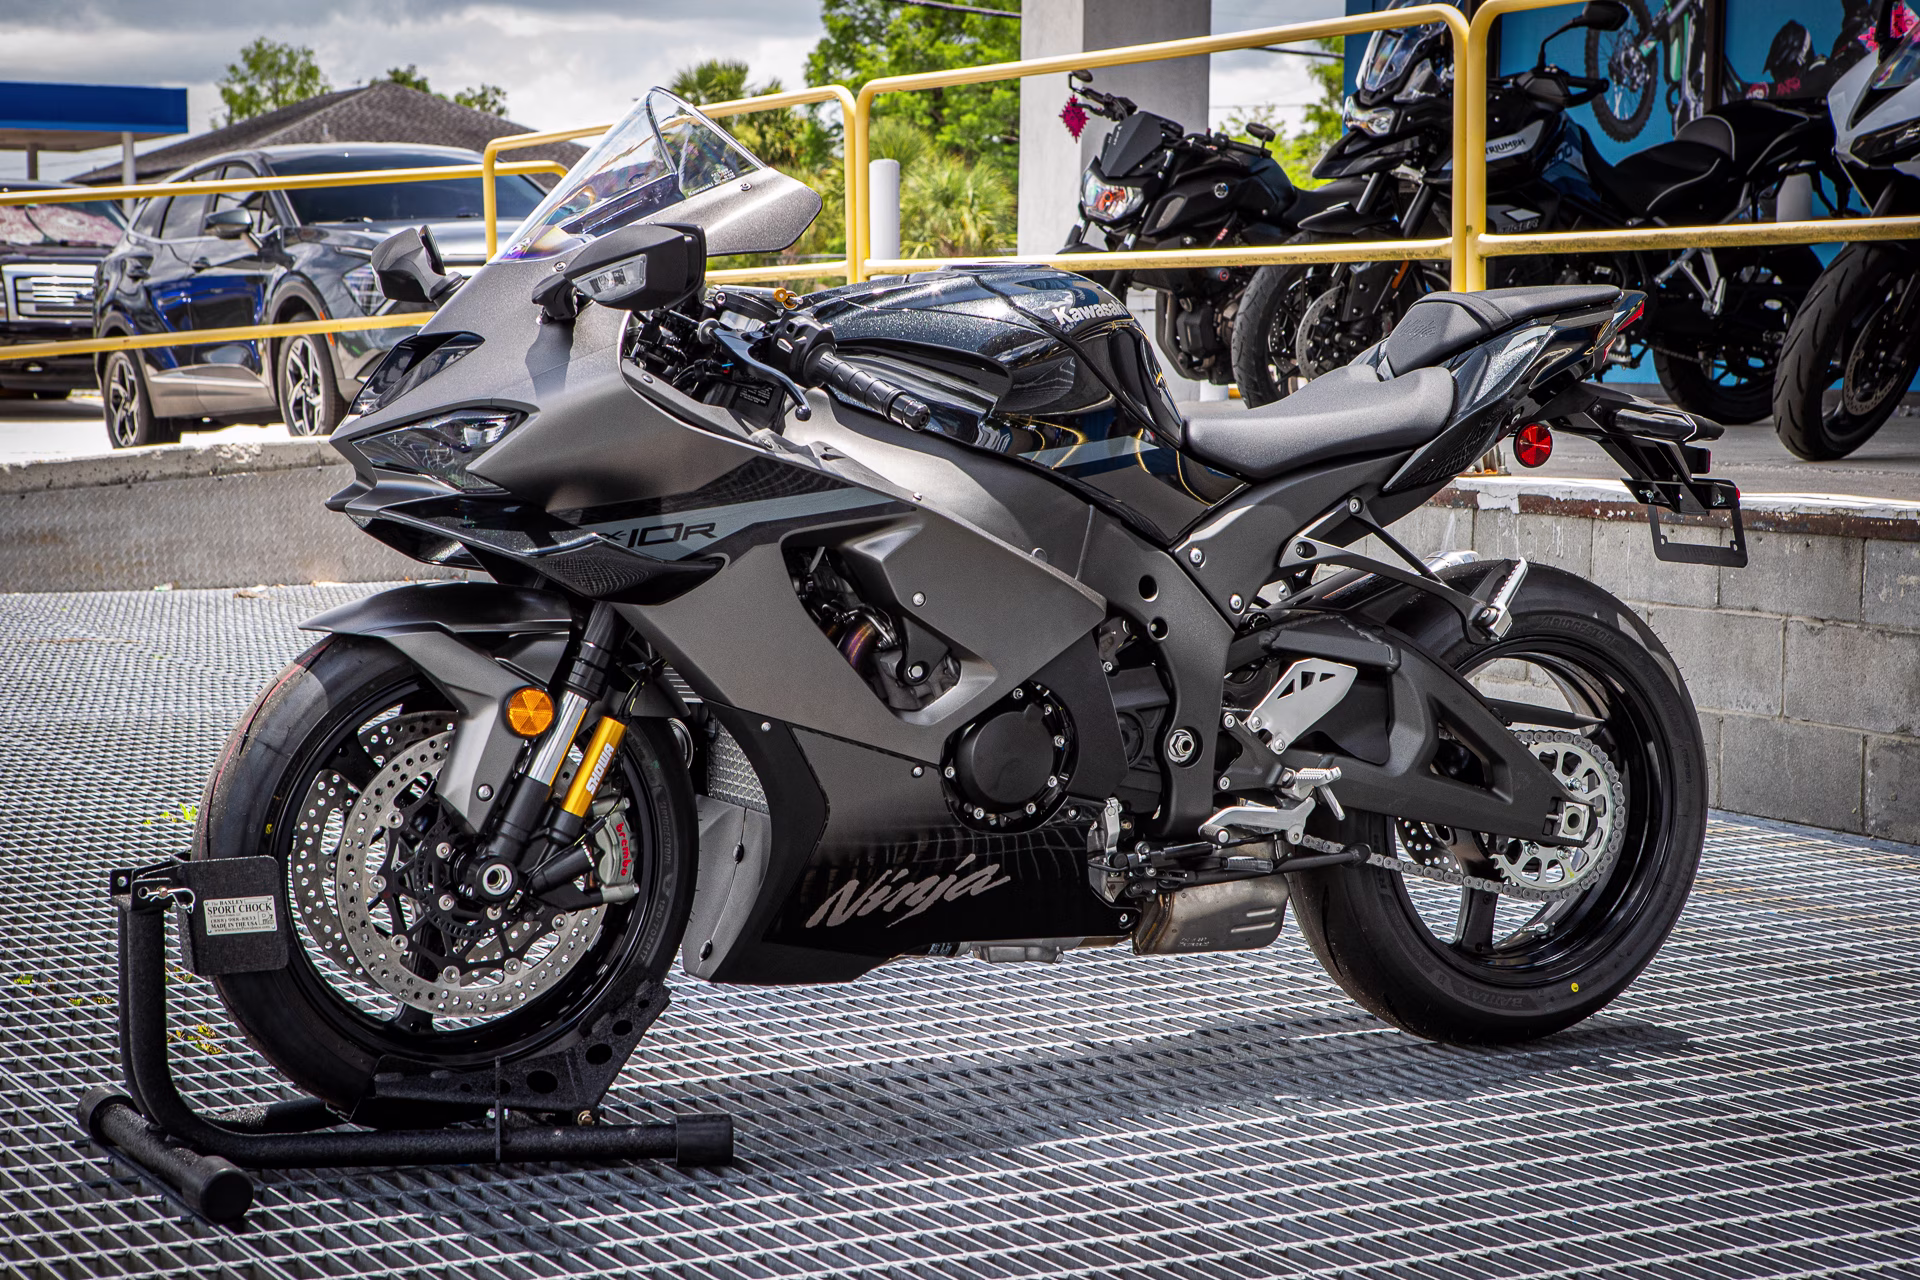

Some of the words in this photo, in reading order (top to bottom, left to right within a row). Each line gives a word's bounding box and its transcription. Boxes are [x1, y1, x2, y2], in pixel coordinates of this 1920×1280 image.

[586, 742, 615, 796] SHOWA
[615, 821, 633, 877] brembo
[207, 905, 237, 915] SPORT
[238, 902, 272, 912] CHOCK
[805, 853, 1011, 928] Ninja
